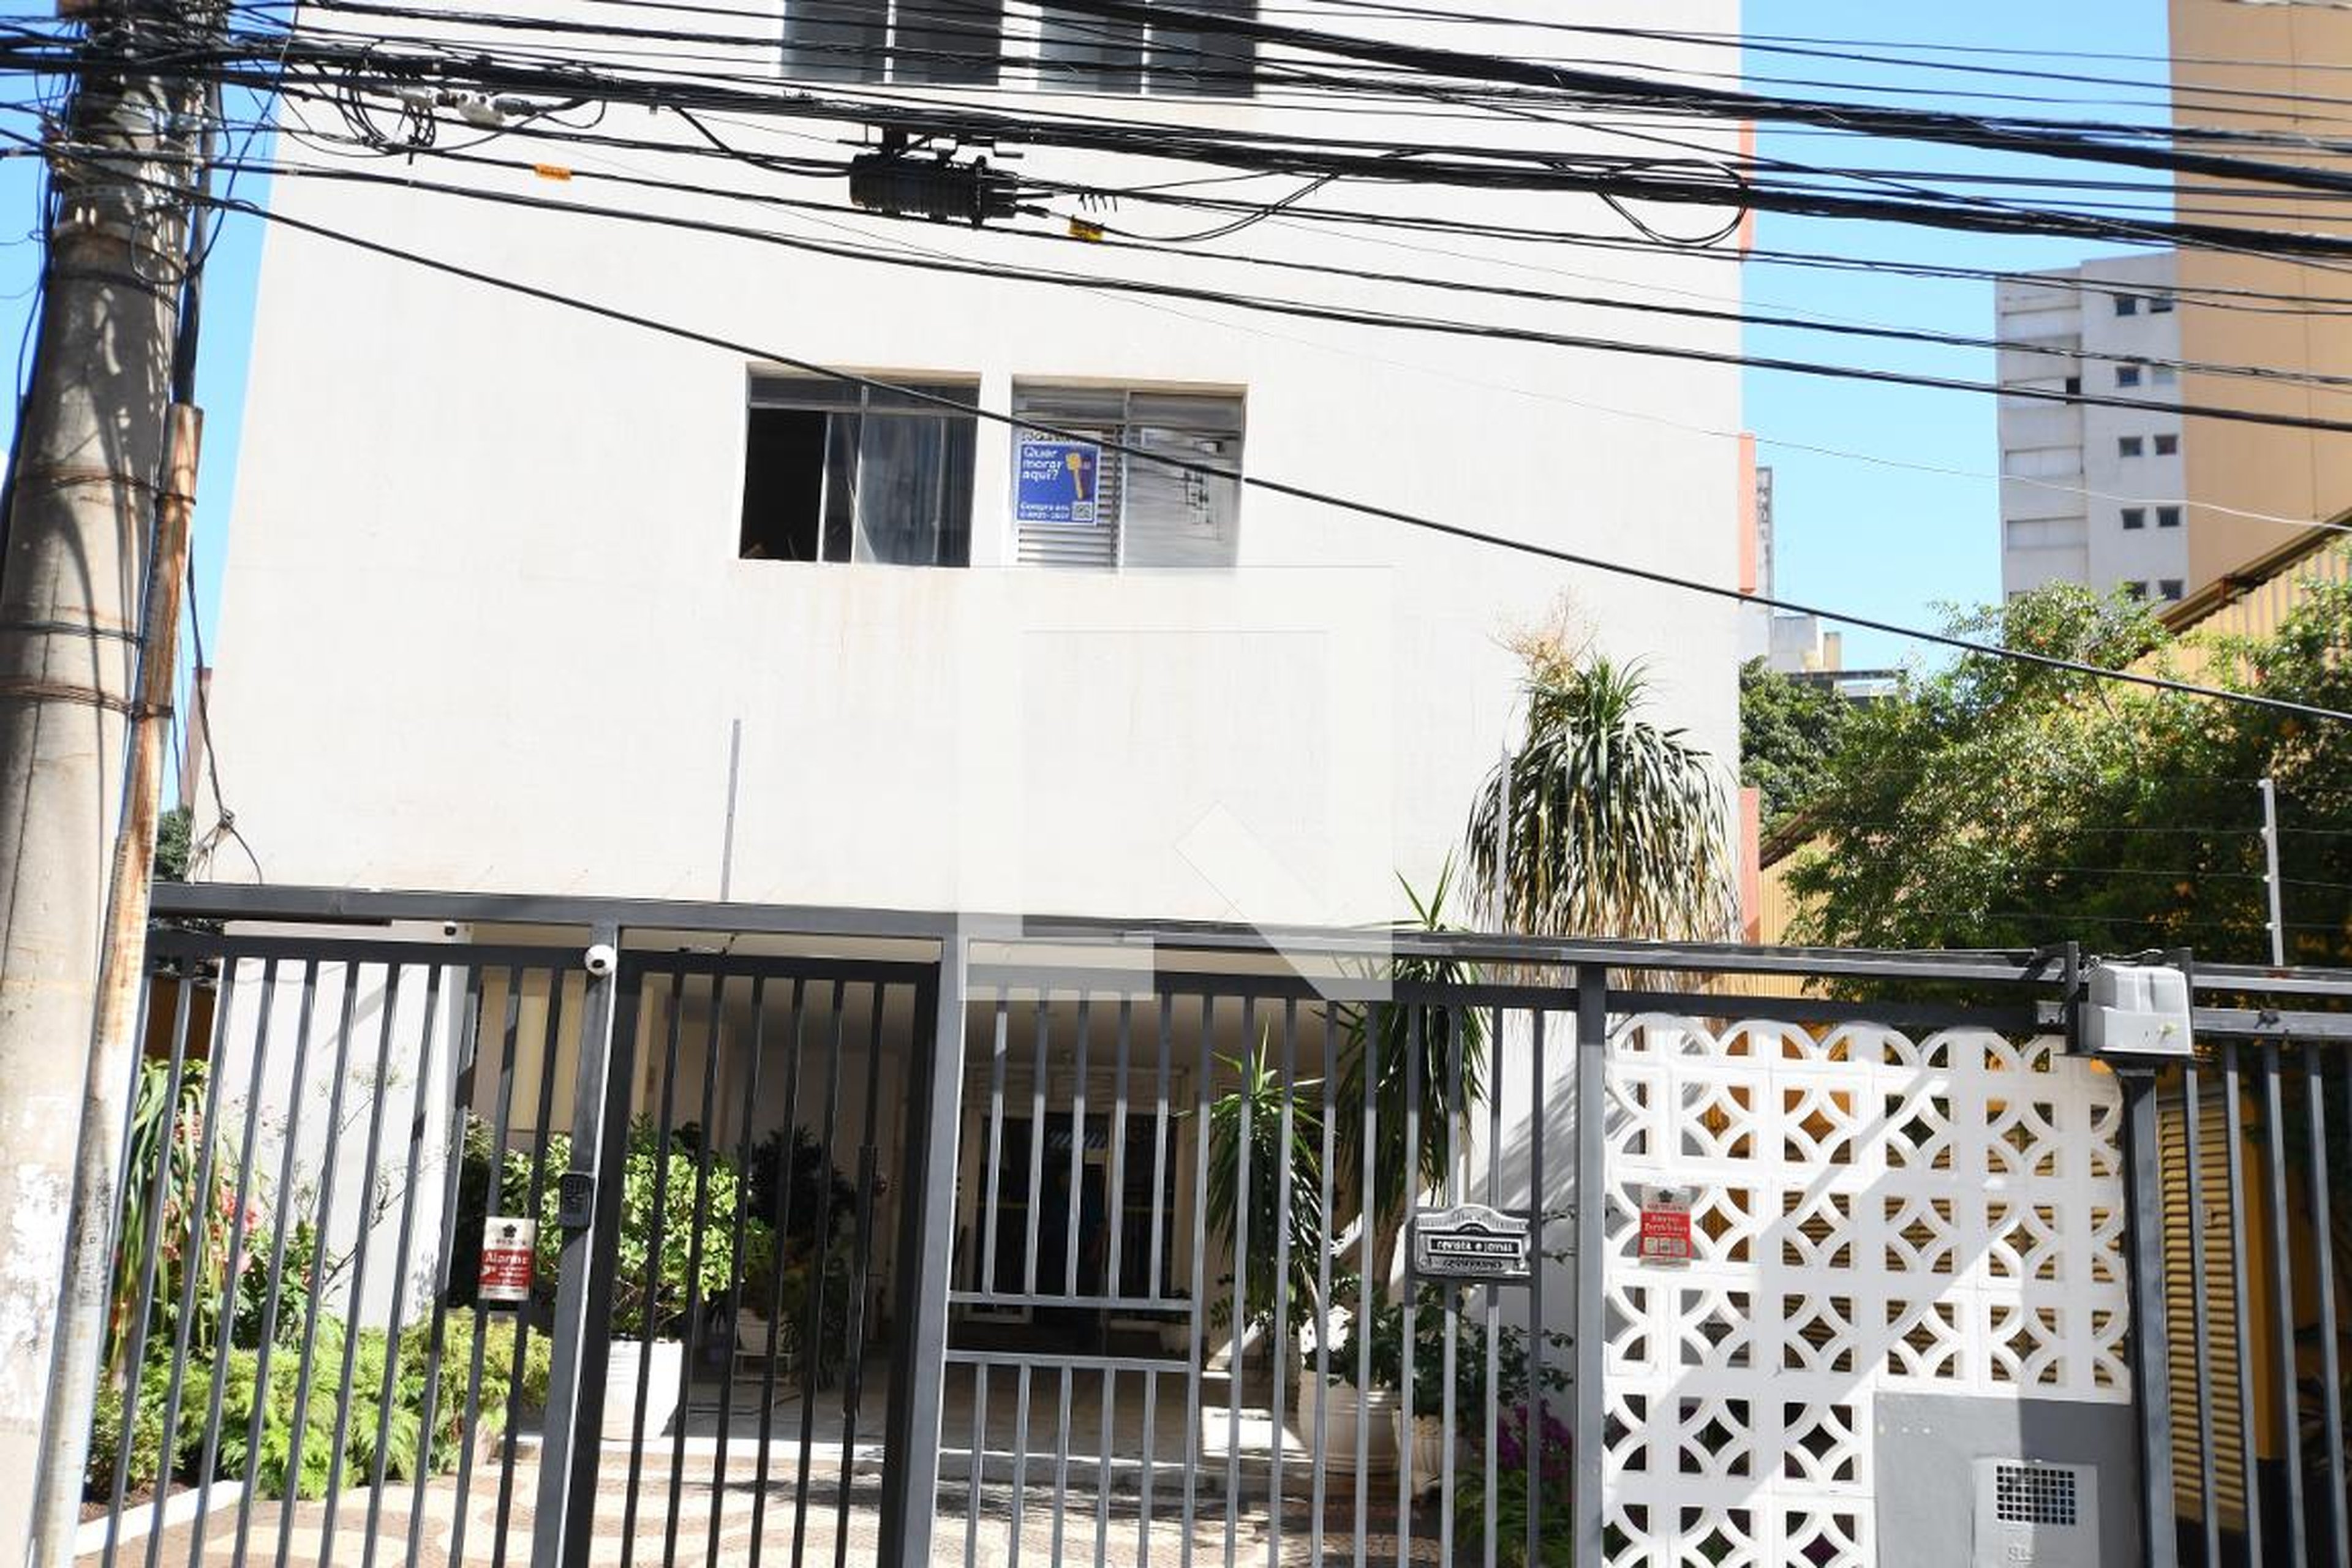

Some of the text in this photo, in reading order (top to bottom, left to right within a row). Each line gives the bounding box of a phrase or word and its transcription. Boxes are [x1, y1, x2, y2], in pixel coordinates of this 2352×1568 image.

[1023, 447, 1058, 458] Quer
[1022, 459, 1062, 469] morar
[1022, 469, 1058, 482] aqui?
